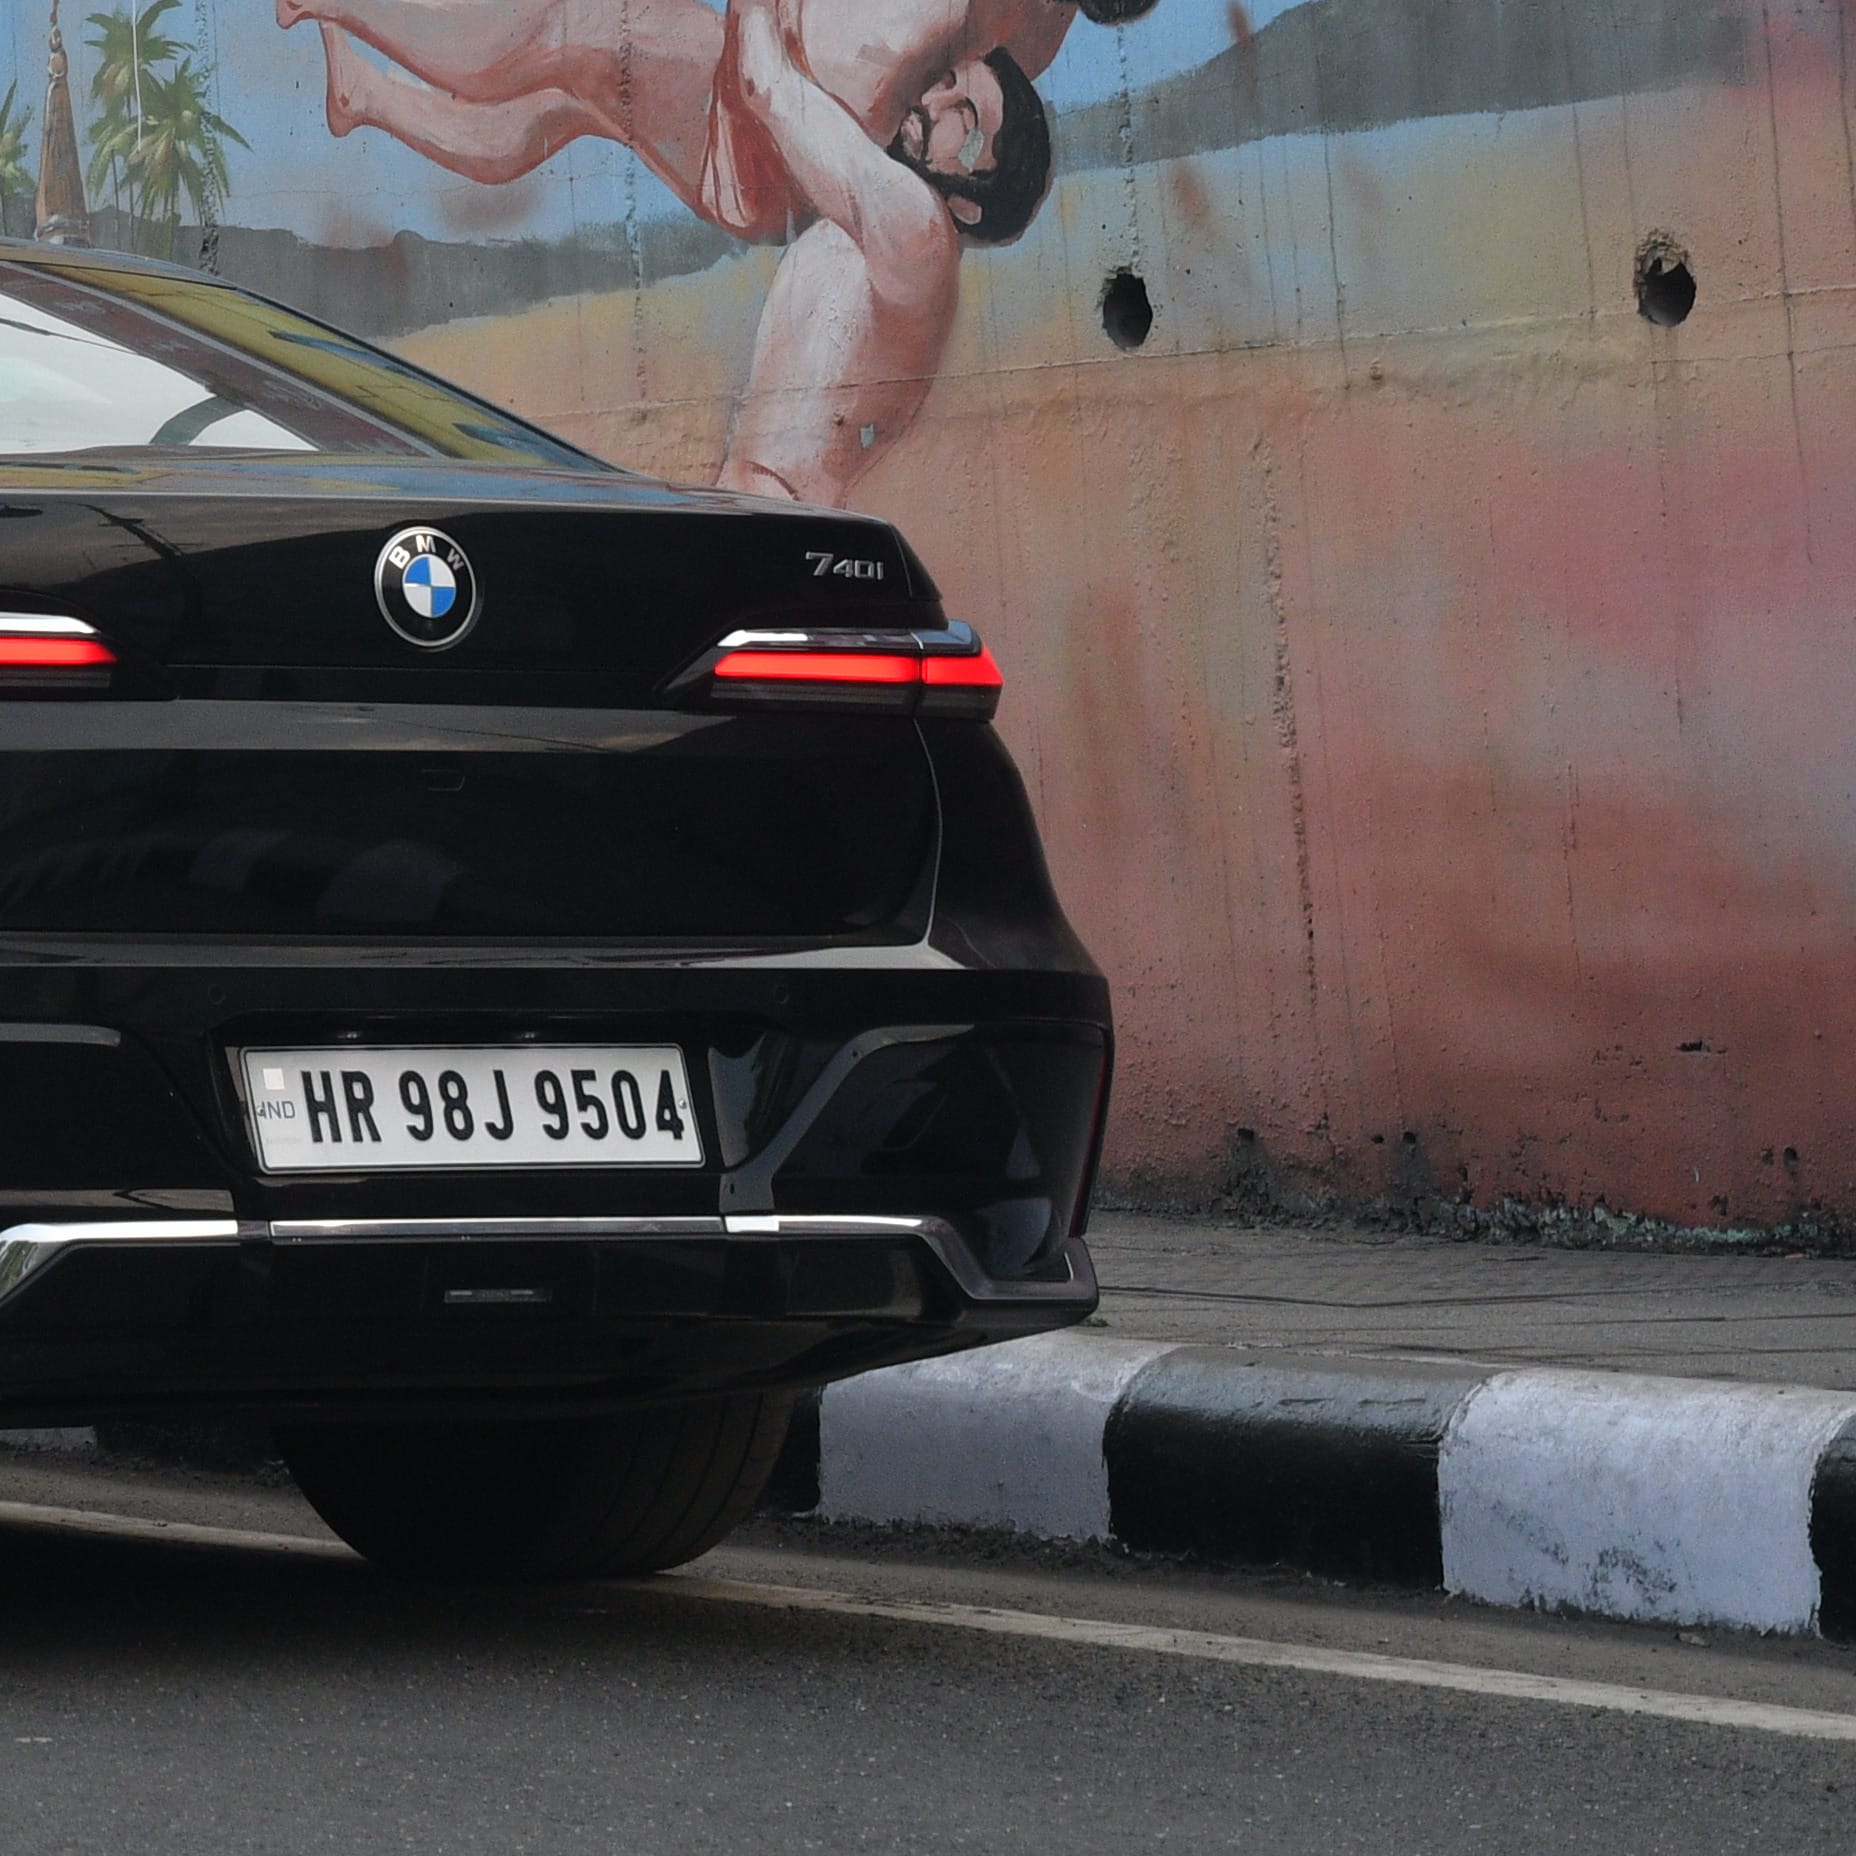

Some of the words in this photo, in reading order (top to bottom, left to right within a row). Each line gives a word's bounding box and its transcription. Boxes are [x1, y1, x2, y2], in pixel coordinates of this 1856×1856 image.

[388, 534, 465, 571] BMW
[301, 1070, 381, 1143] HR
[534, 1069, 684, 1141] 9504
